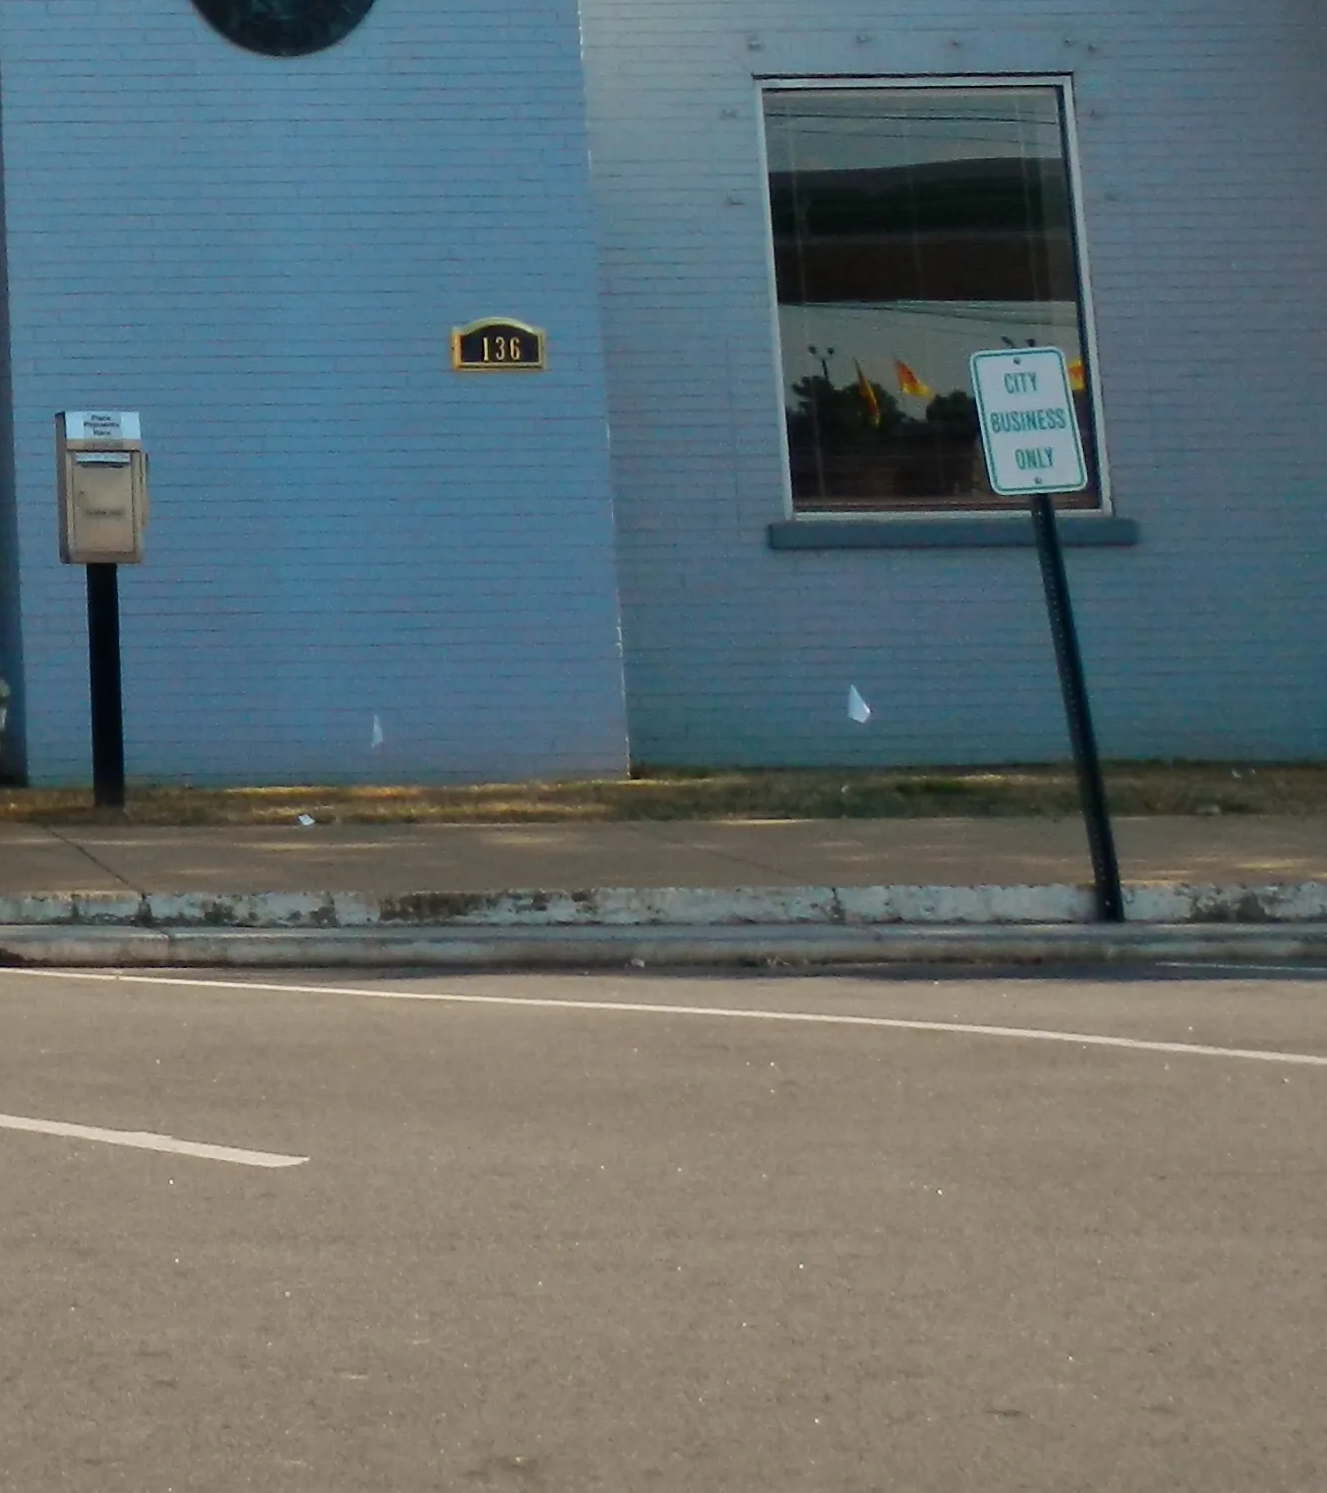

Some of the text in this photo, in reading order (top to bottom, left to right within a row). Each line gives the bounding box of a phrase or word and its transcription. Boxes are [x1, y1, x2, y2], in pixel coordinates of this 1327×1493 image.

[482, 336, 521, 362] 136
[1003, 371, 1038, 395] CITY
[989, 407, 1068, 434] BUSINESS
[1014, 446, 1055, 471] ONLY
